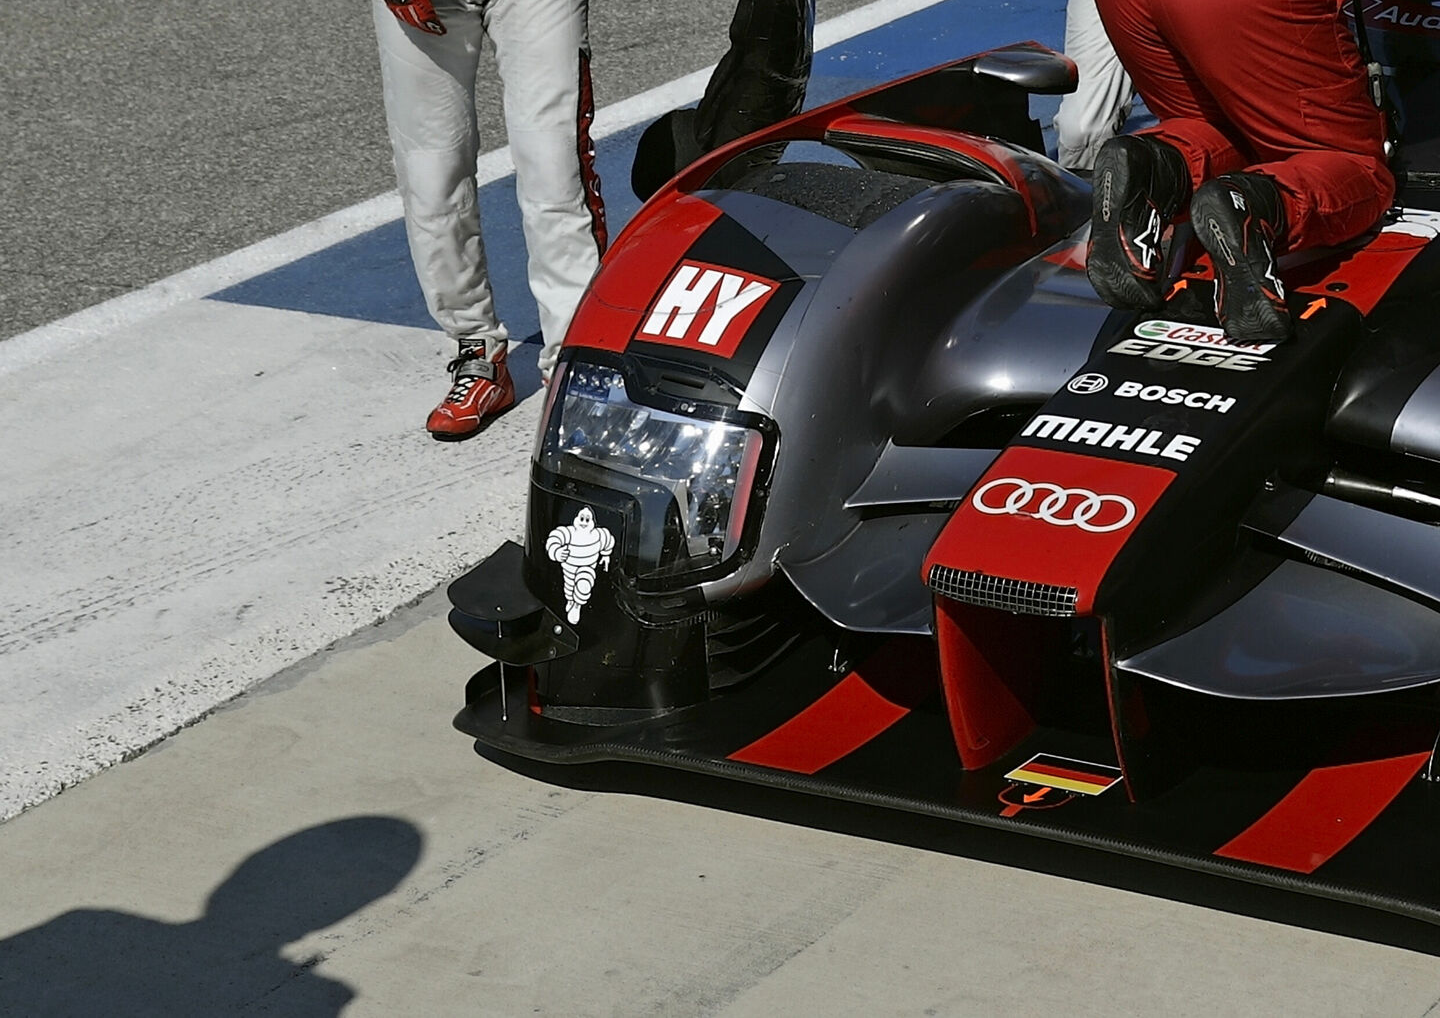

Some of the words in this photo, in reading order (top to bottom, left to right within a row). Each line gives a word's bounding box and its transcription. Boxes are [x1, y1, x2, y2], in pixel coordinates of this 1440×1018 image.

[641, 265, 772, 347] HY
[1106, 338, 1272, 371] EDGE
[1114, 381, 1237, 413] BOSCH
[1020, 413, 1201, 462] MAHLE
